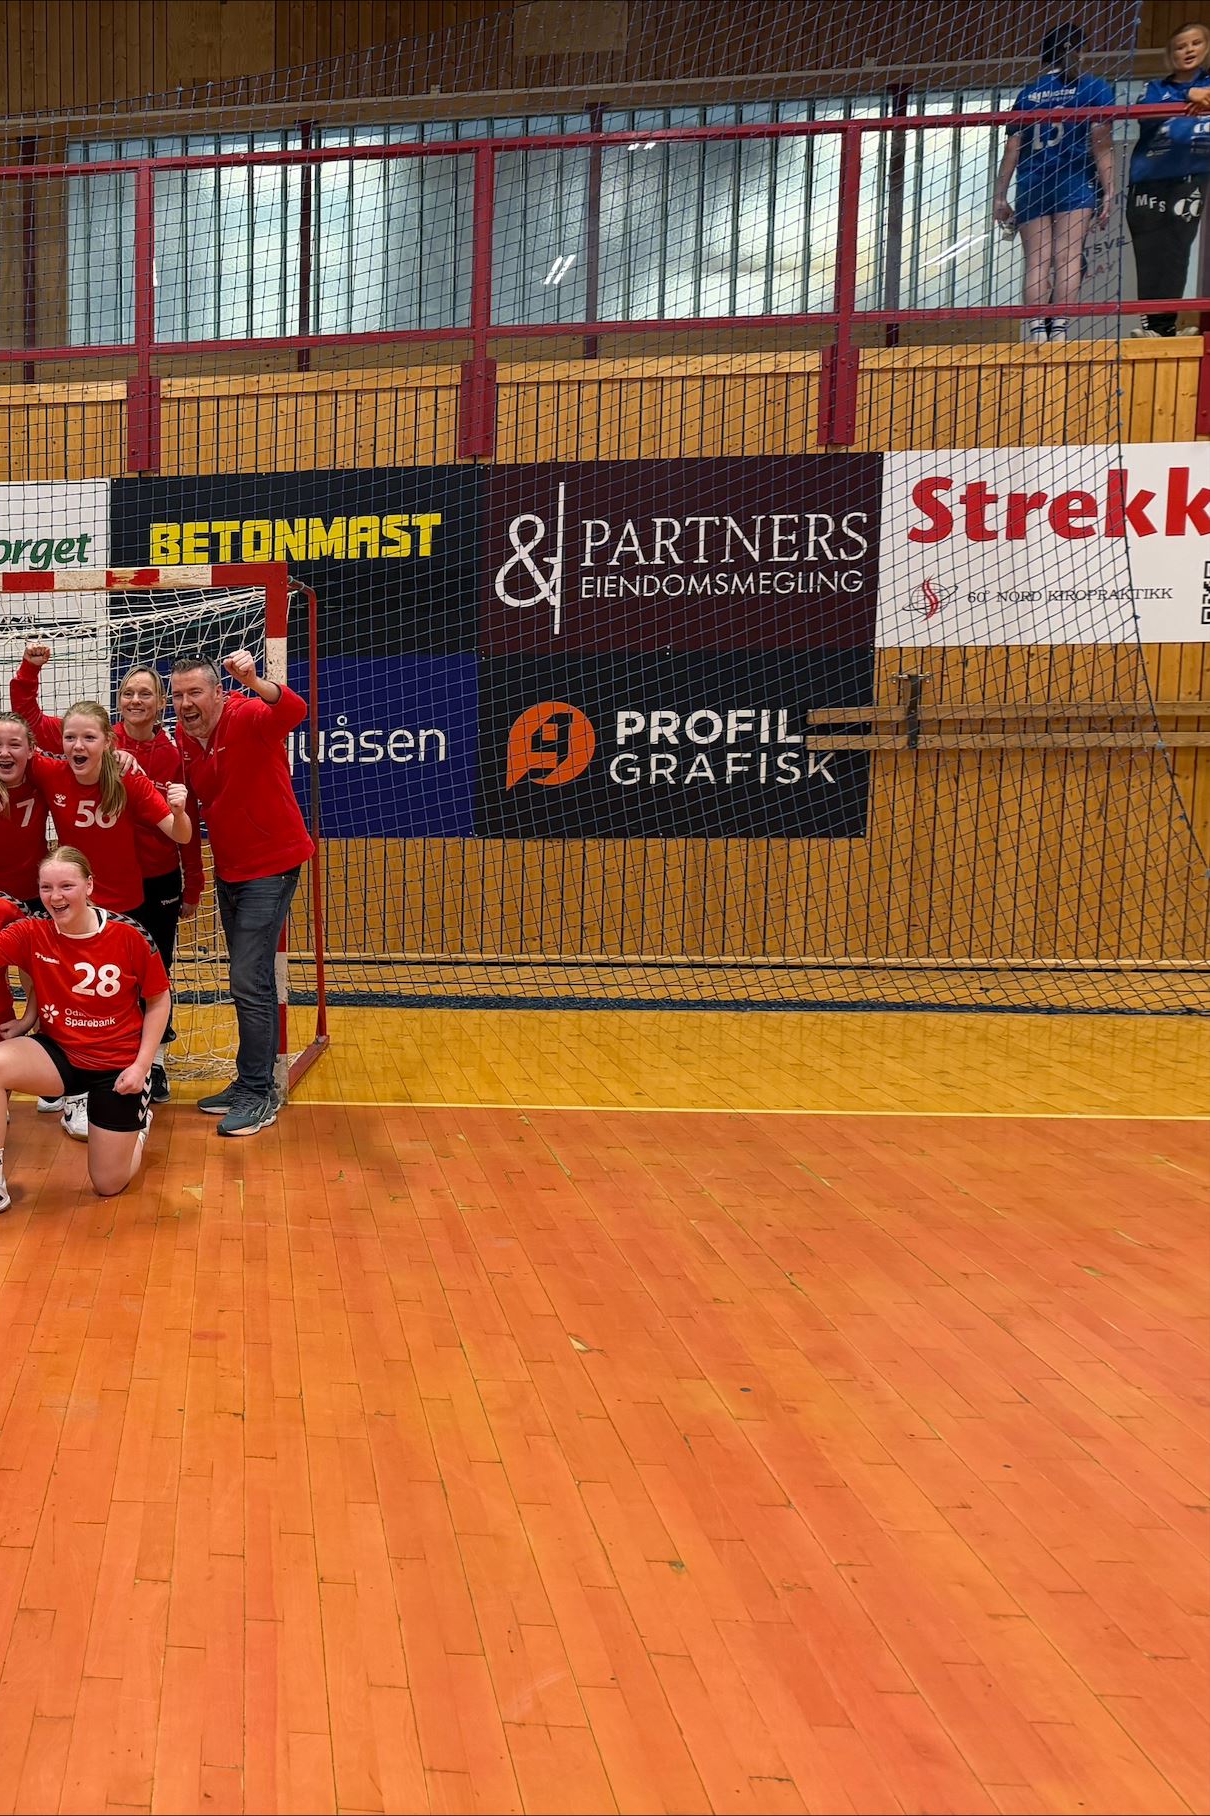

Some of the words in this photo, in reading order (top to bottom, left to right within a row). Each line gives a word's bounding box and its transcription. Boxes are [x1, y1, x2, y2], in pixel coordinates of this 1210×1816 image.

[1135, 193, 1167, 213] MFS
[908, 466, 1210, 544] Strekk
[149, 512, 442, 565] BETONMAST
[580, 510, 869, 567] PARTNERS
[580, 569, 864, 599] EIENDOMSMEGLING
[996, 590, 1043, 603] NORD
[1048, 588, 1174, 601] KIROPRAKTIKK
[616, 708, 805, 746] PROFIL
[609, 751, 836, 786] GRAFISK
[16, 797, 35, 828] 7
[71, 962, 121, 998] 28
[64, 1016, 117, 1029] Sparebank
